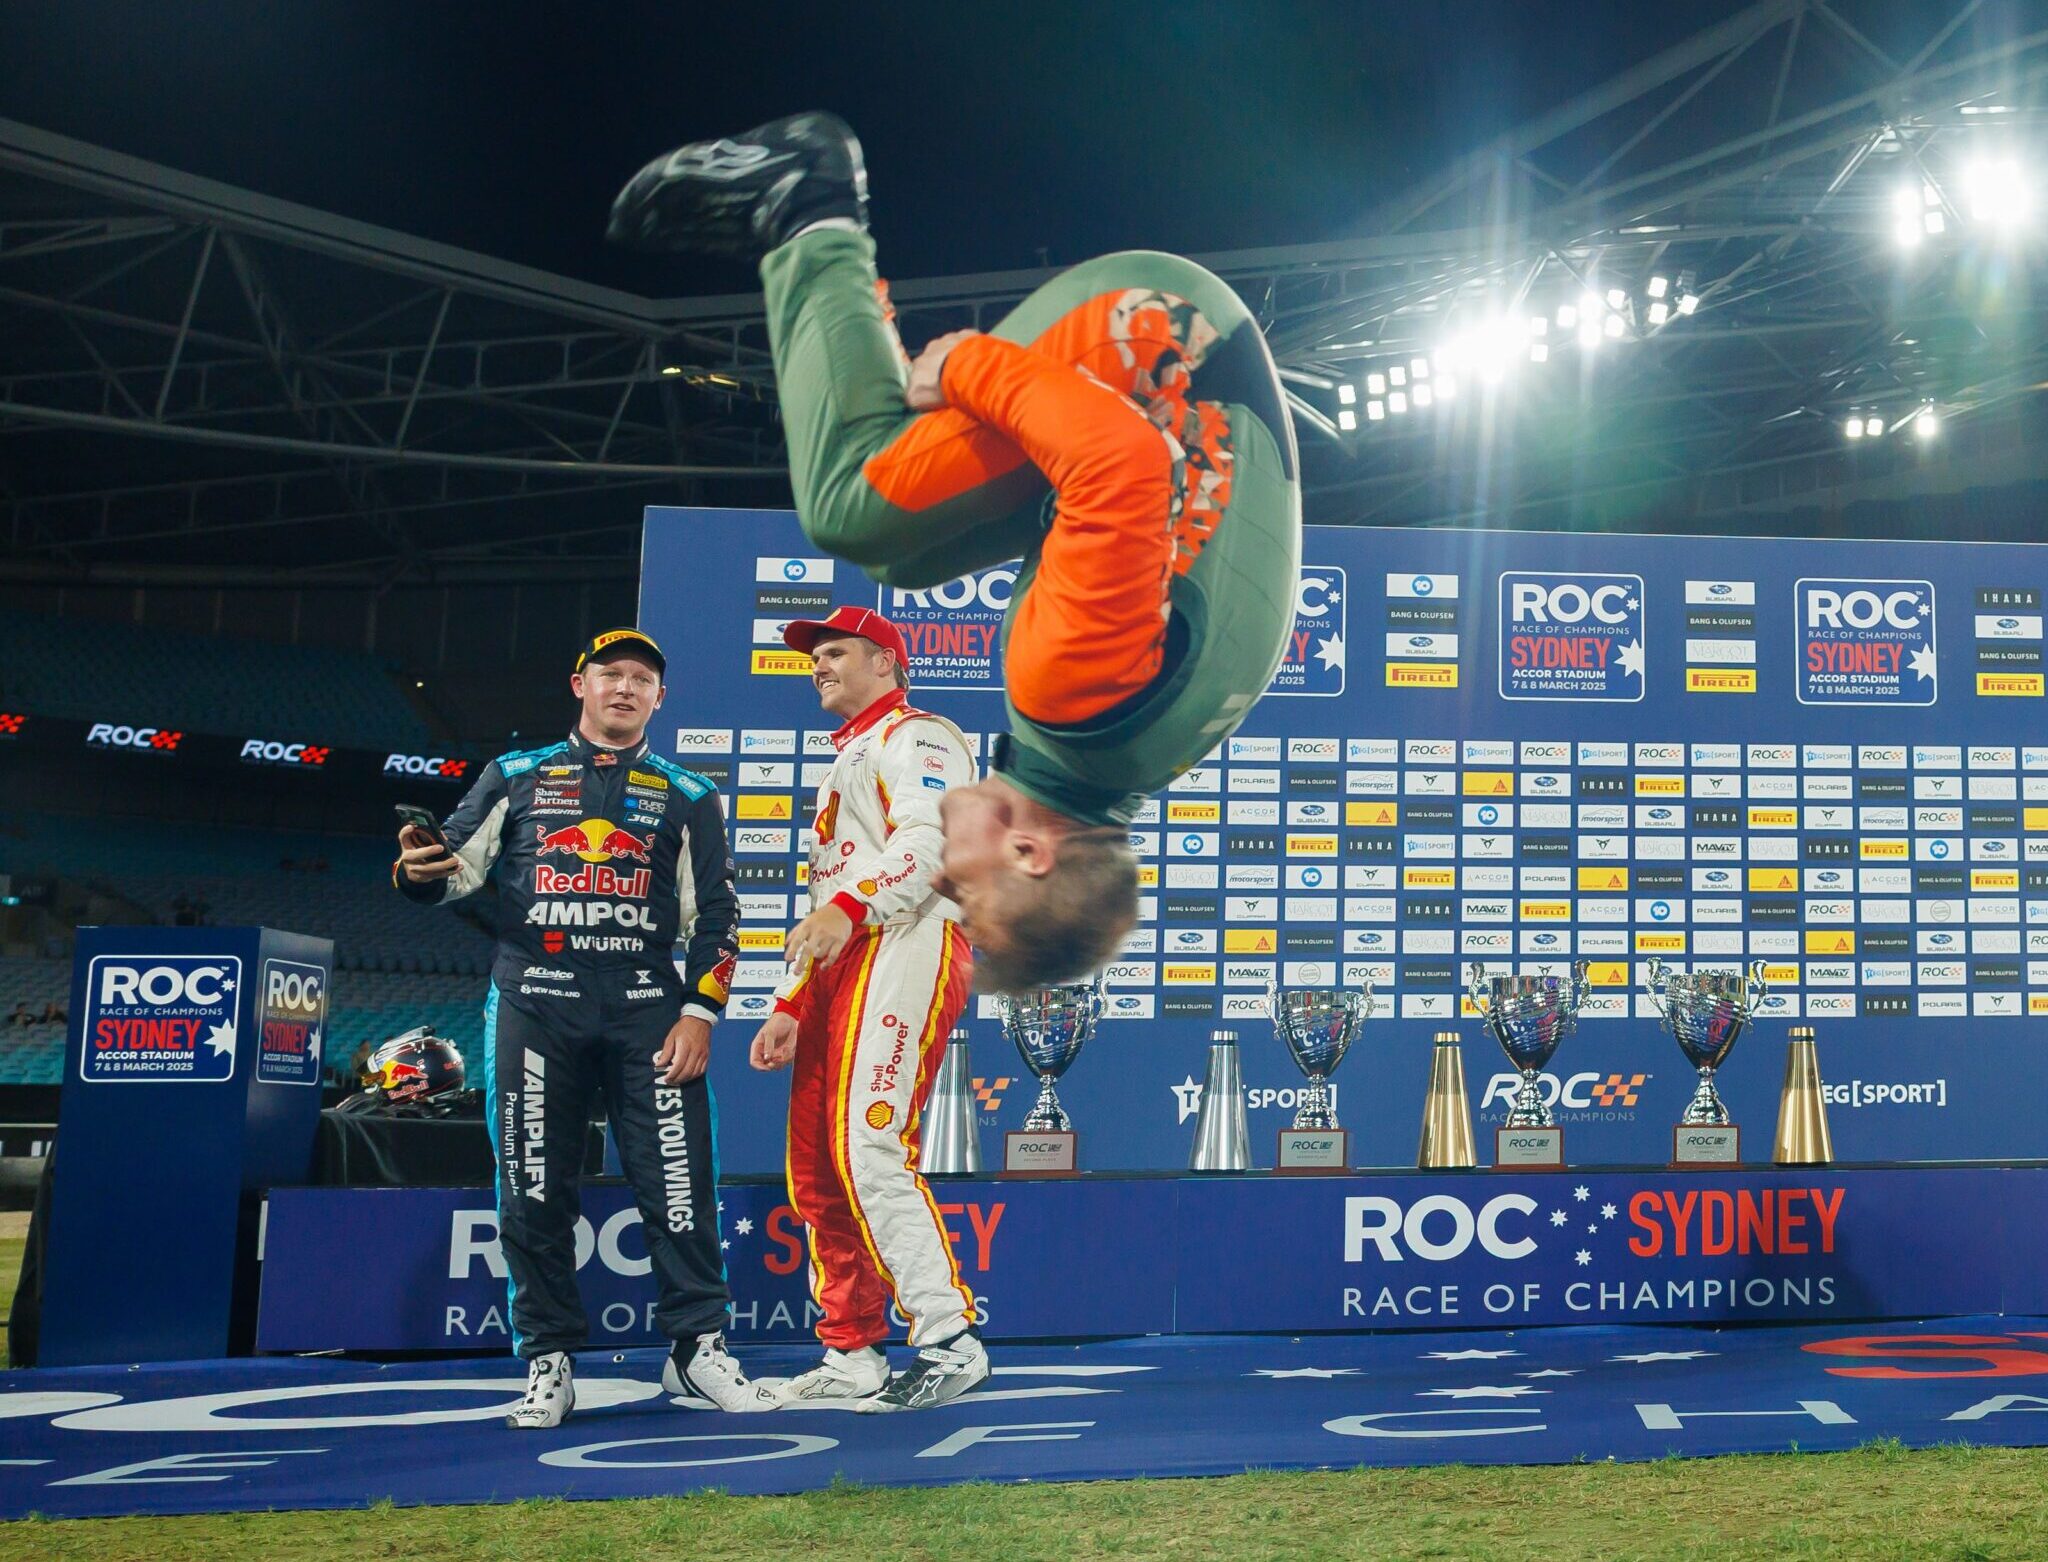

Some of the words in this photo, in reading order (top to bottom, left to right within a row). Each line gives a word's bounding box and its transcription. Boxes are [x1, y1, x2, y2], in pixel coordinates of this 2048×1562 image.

[1513, 584, 1630, 623] ROC
[1808, 590, 1920, 629] ROC
[892, 611, 922, 619] RACE
[927, 611, 943, 620] OF
[947, 612, 1006, 621] CHAMPIO
[1513, 625, 1540, 633] RACE
[1564, 626, 1629, 634] CHAMPIONS
[1809, 631, 1835, 641] RACE
[1858, 632, 1921, 640] CHAMPIONS
[1511, 637, 1610, 668] SYDNEY
[1808, 642, 1903, 672] SYDNEY
[908, 657, 933, 666] COR
[935, 657, 990, 667] STADIUM
[909, 669, 915, 678] 8
[918, 669, 960, 679] MARCH
[963, 670, 990, 679] 2025
[1392, 668, 1451, 683] PIRELLI
[1513, 669, 1551, 678] ACCOR
[1555, 670, 1605, 679] STADIUM
[1809, 674, 1847, 683] ACCOR
[1851, 675, 1899, 683] STADIUM
[1279, 676, 1305, 685] 2025
[1521, 681, 1527, 689] &
[1530, 681, 1537, 689] 8
[1539, 681, 1578, 689] MARCH
[1581, 682, 1606, 690] 2025
[1692, 674, 1750, 688] PIRELLI
[1983, 678, 2038, 692] PIRELLI
[1835, 686, 1873, 694] MARCH
[1876, 686, 1899, 694] 2025
[86, 723, 156, 748] ROC
[681, 734, 714, 745] ROC
[240, 739, 306, 762] ROC
[1291, 743, 1322, 754] ROC
[1409, 745, 1440, 755] ROC
[1525, 746, 1555, 757] ROC
[1751, 750, 1780, 760] ROC
[1862, 750, 1892, 761] ROC
[1972, 751, 2001, 762] ROC
[383, 753, 444, 776] ROC
[534, 787, 562, 797] Shaw
[534, 796, 580, 806] Partners
[627, 813, 660, 826] JGI
[1918, 812, 1947, 823] ROC
[739, 833, 770, 844] ROC
[535, 864, 593, 895] Red
[594, 864, 652, 899] Bull
[1808, 905, 1838, 915] ROC
[524, 901, 658, 932] AMPOL
[1465, 935, 1495, 946] ROC
[1106, 966, 1137, 977] ROC
[1347, 967, 1378, 978] ROC
[1921, 966, 1950, 977] ROC
[101, 966, 226, 1005] ROC
[267, 970, 319, 1012] ROC
[531, 986, 548, 994] NEW
[625, 987, 664, 1000] BROWN
[1226, 999, 1258, 1010] ROC
[1810, 998, 1839, 1009] ROC
[96, 1019, 201, 1049] SYDNEY
[263, 1022, 308, 1053] SYDNEY
[96, 1051, 137, 1059] ACCOR
[141, 1051, 194, 1059] STADIUM
[883, 1022, 910, 1093] V-Power
[95, 1063, 102, 1071] 7
[104, 1063, 111, 1071] &
[113, 1063, 120, 1071] 8
[870, 1065, 884, 1093] Shell
[504, 1092, 518, 1156] Premium
[523, 1069, 545, 1203] AMPLIFY
[657, 1111, 688, 1158] YOU
[1291, 1141, 1320, 1150] ROC
[1509, 1138, 1537, 1148] ROC
[1687, 1136, 1714, 1145] ROC
[1018, 1143, 1048, 1153] ROC
[663, 1159, 694, 1233] WINGS
[1344, 1194, 1538, 1262] ROC
[1629, 1188, 1845, 1257] SYDNEY
[1343, 1286, 1459, 1317] RACE
[1483, 1283, 1541, 1313] OF
[1564, 1276, 1836, 1312] CHAMPIONS
